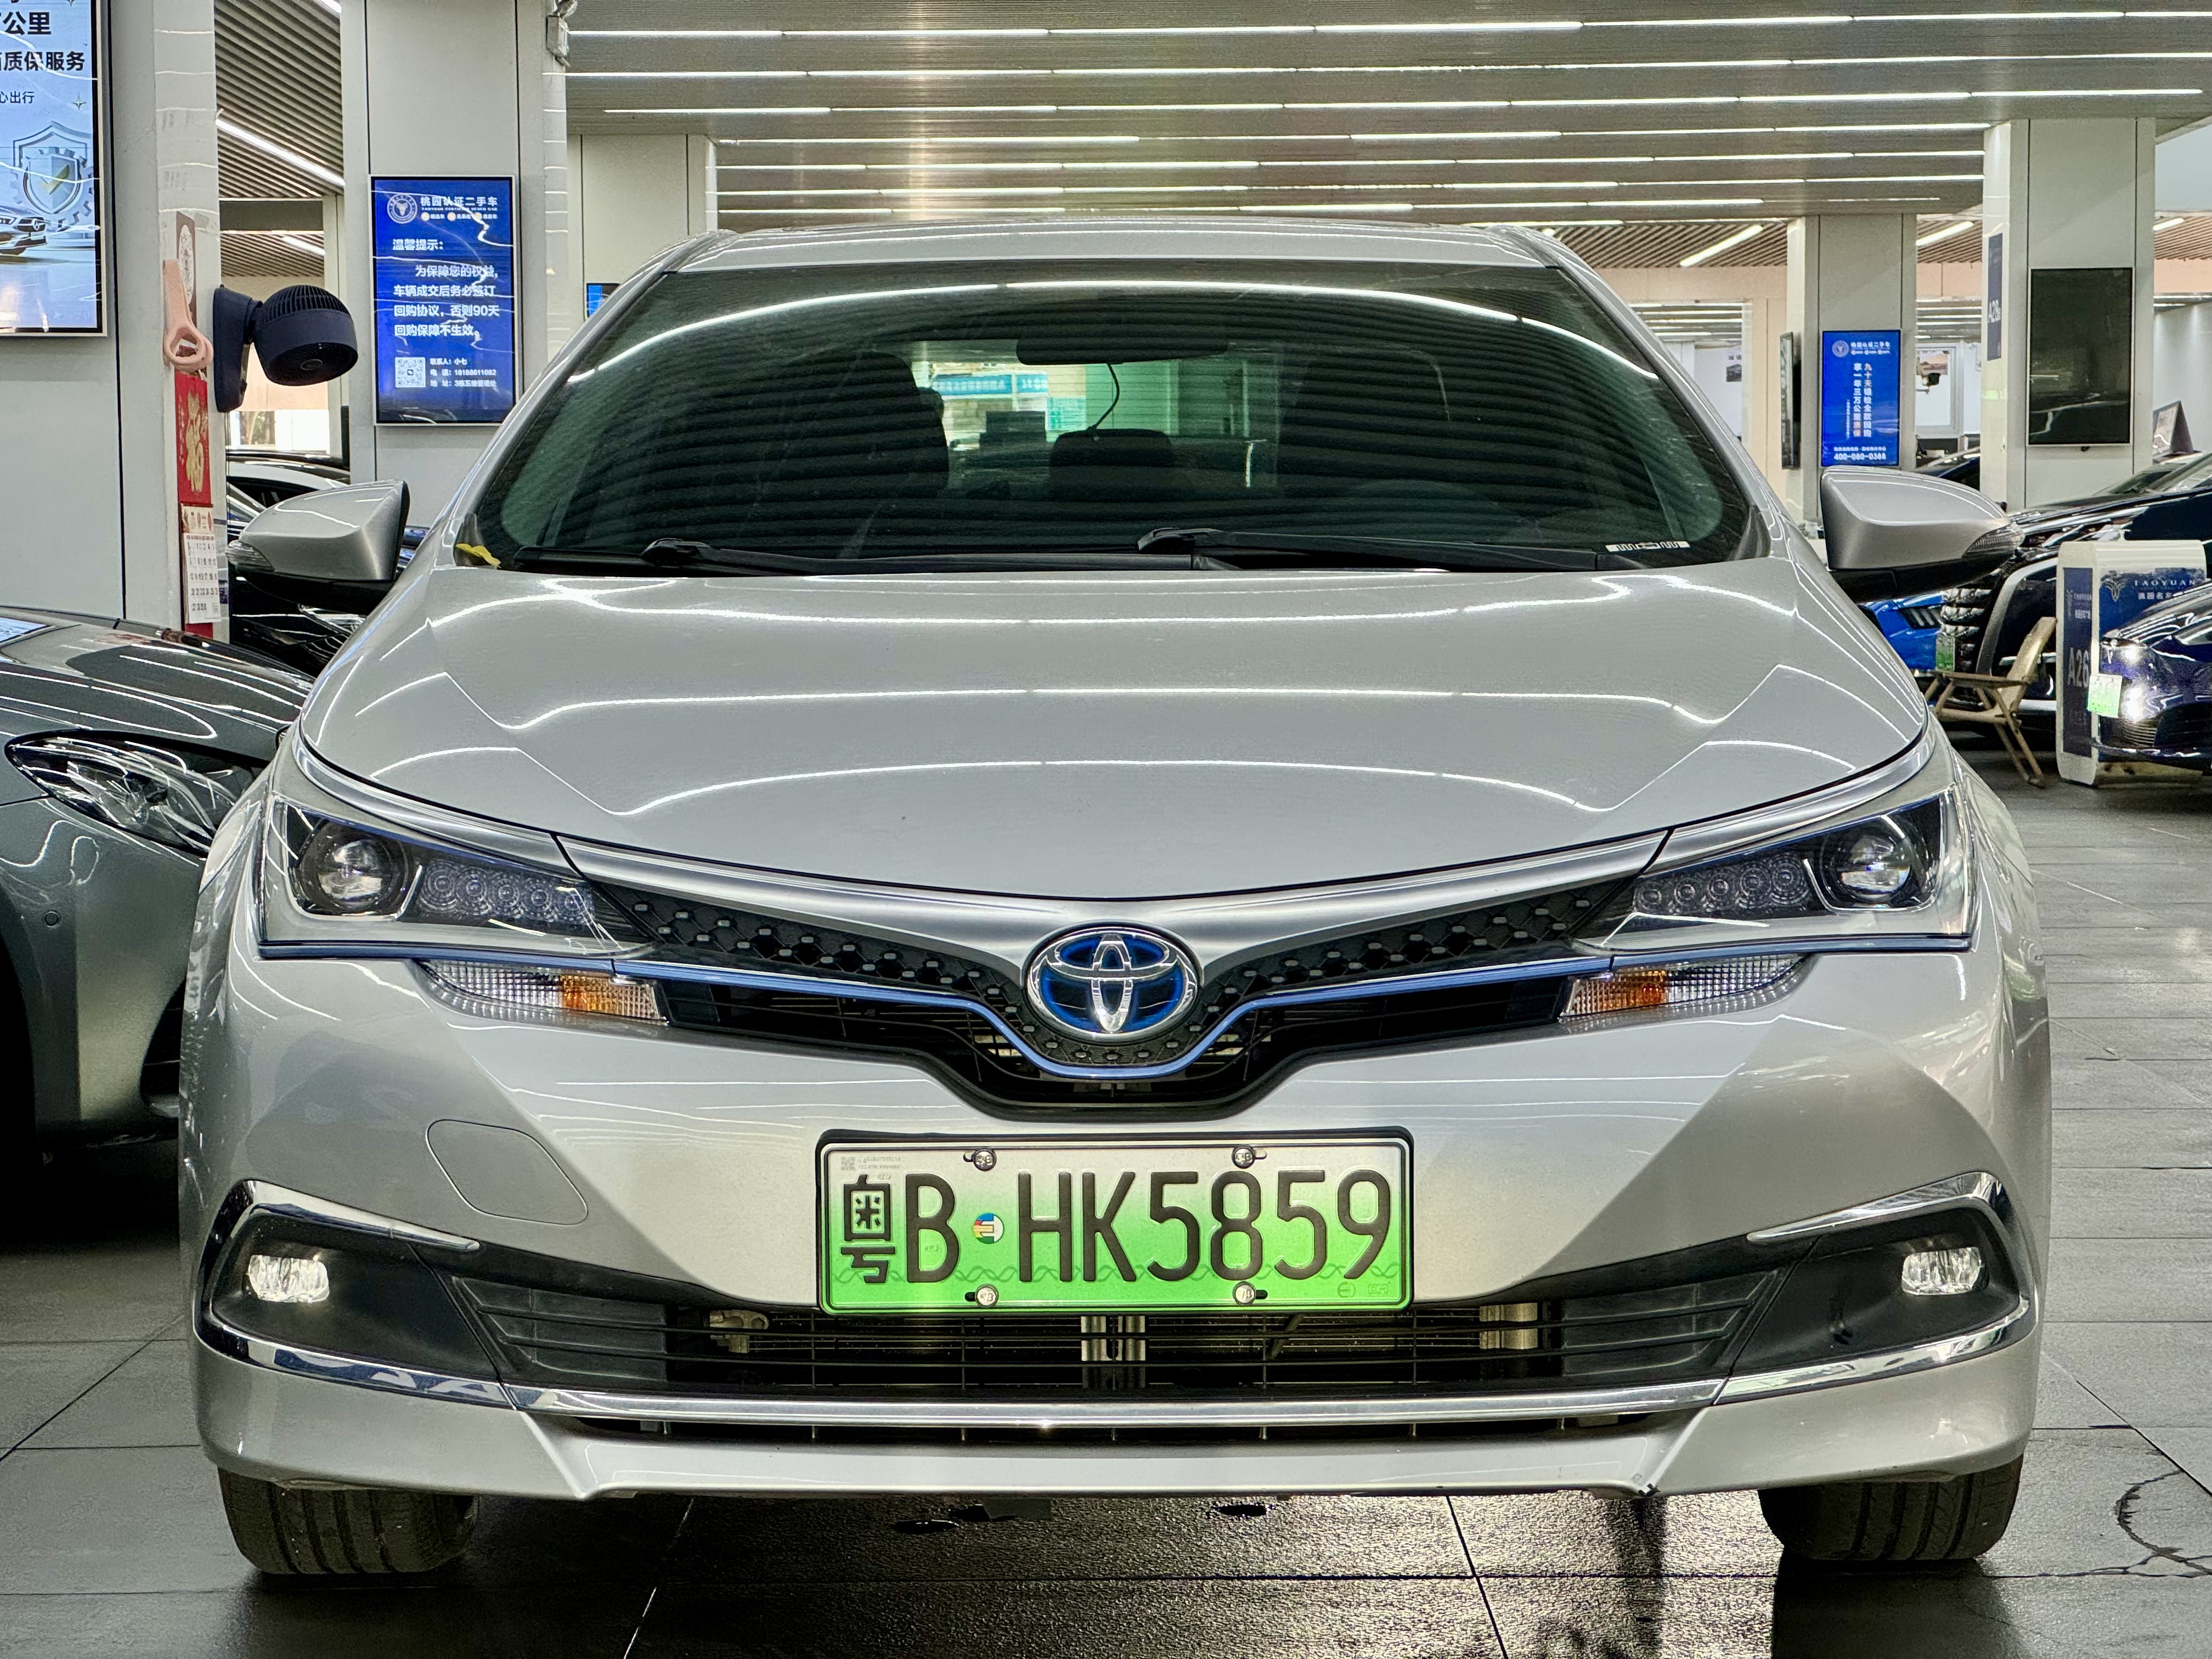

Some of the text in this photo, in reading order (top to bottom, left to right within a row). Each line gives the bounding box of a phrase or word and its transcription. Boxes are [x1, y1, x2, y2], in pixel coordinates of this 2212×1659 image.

[0, 11, 52, 35] 公里
[0, 50, 85, 71] 质保服务
[420, 196, 498, 206] 桃园认证二手车
[393, 239, 443, 251] 温馨提示：
[415, 265, 498, 278] 为保障您的权益，
[393, 285, 496, 297] 车辆成交后务必签订
[394, 305, 500, 317] 回购协议，否则90天
[394, 324, 479, 337] 回购保障不生效。
[840, 1170, 1392, 1284] 粤B HK5859
